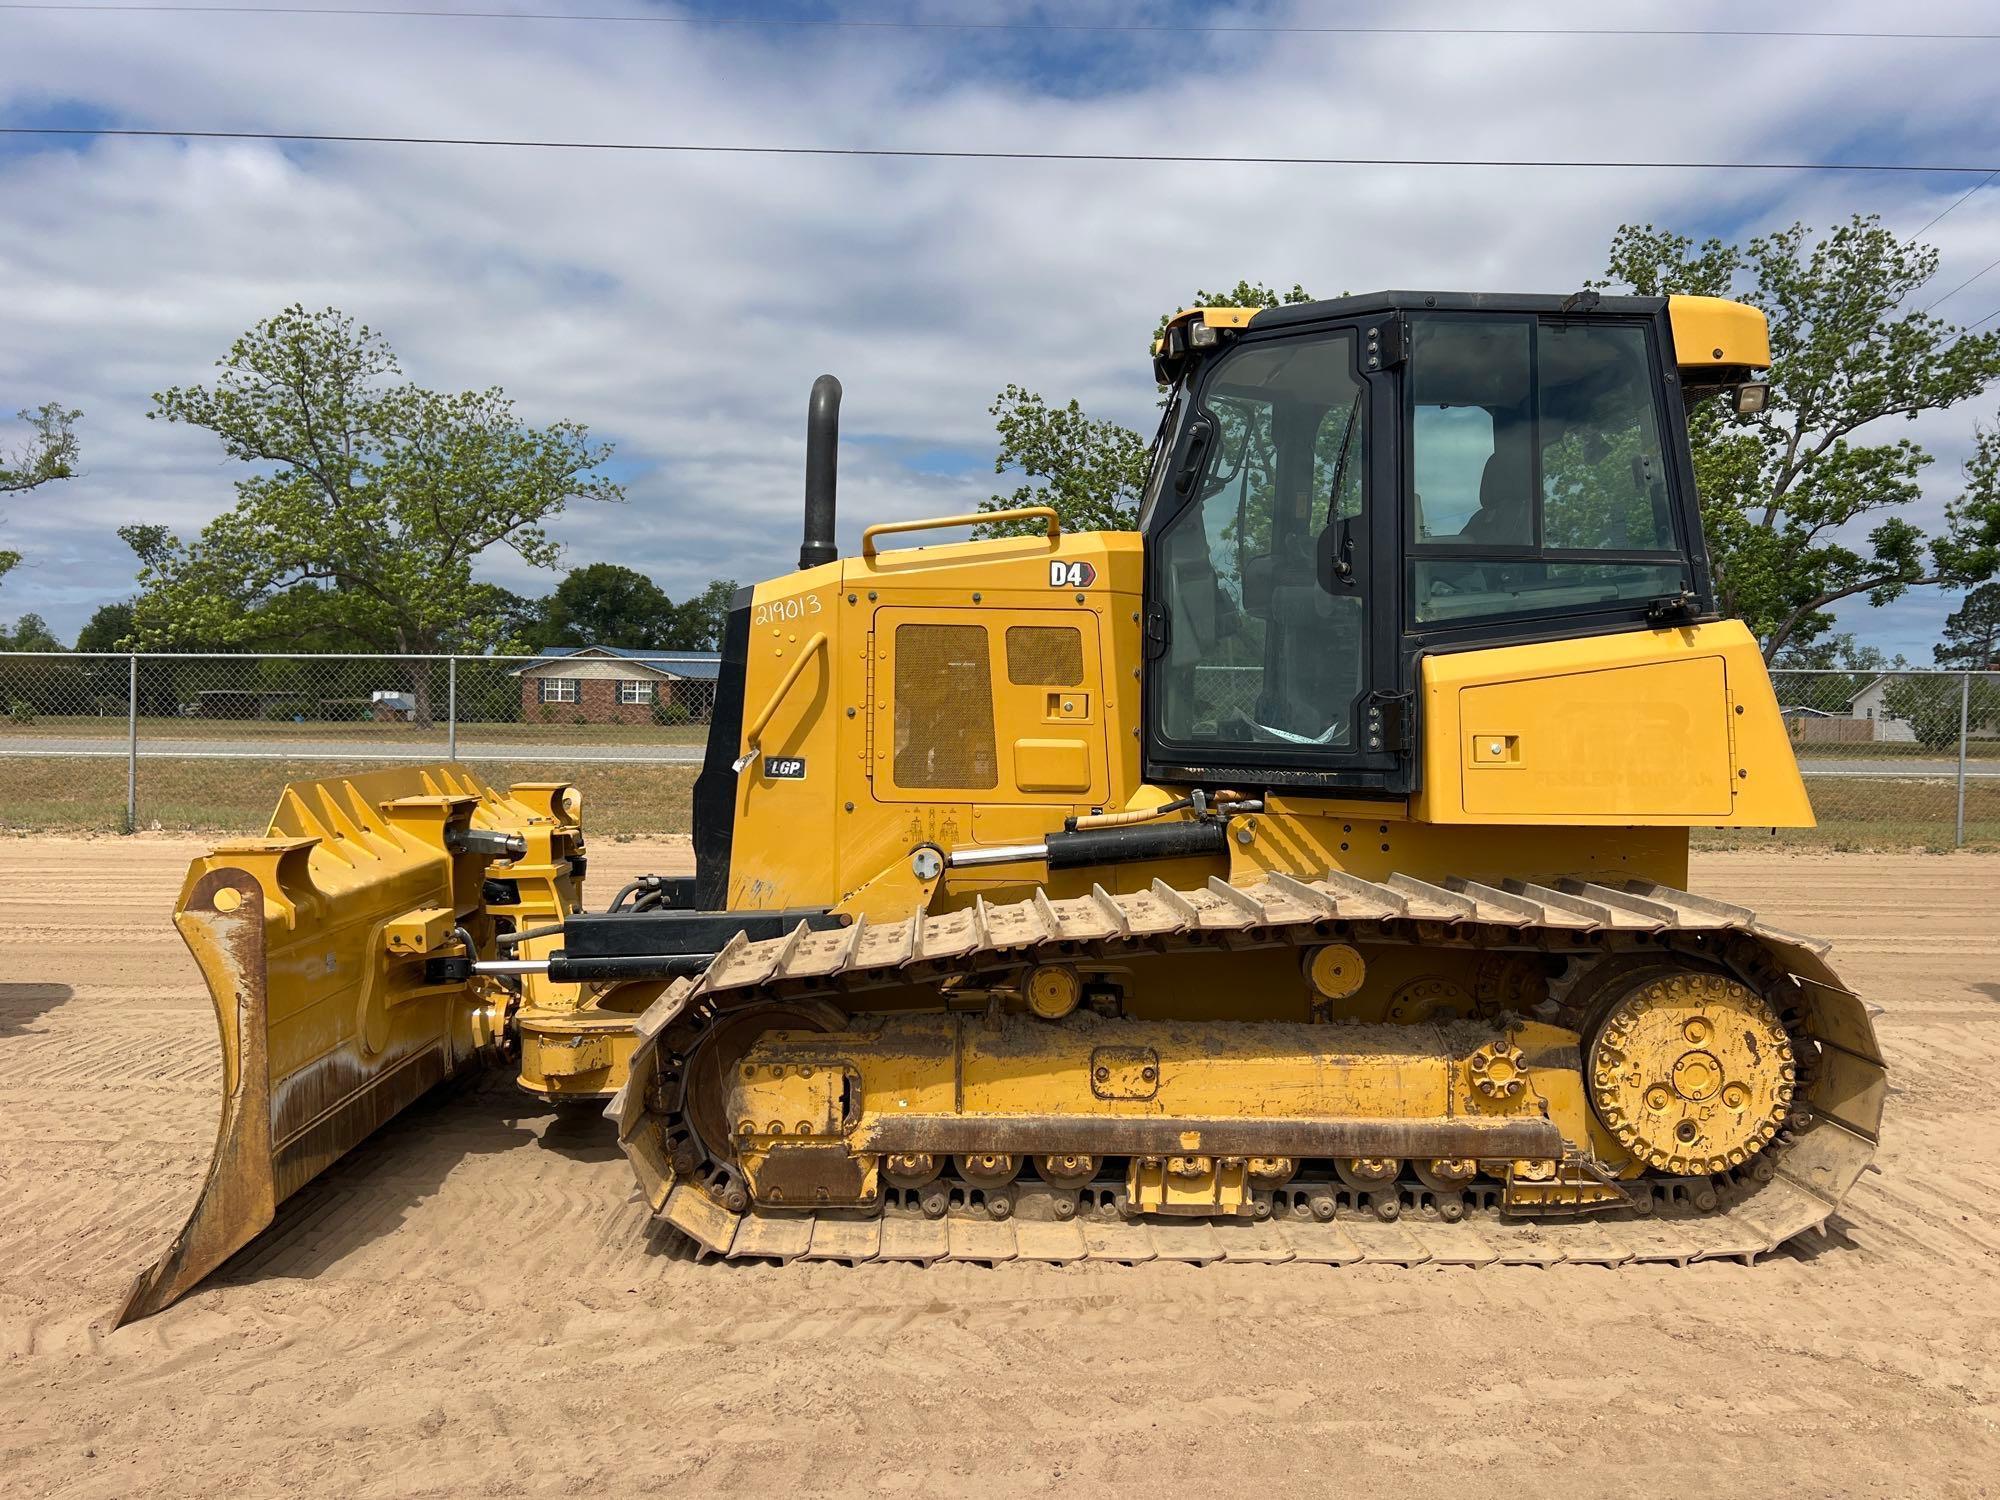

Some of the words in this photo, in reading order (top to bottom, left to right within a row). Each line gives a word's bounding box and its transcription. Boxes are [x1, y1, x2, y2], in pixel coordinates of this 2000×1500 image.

[1050, 561, 1082, 586] D4
[756, 595, 822, 625] 219013
[771, 760, 801, 775] LGP
